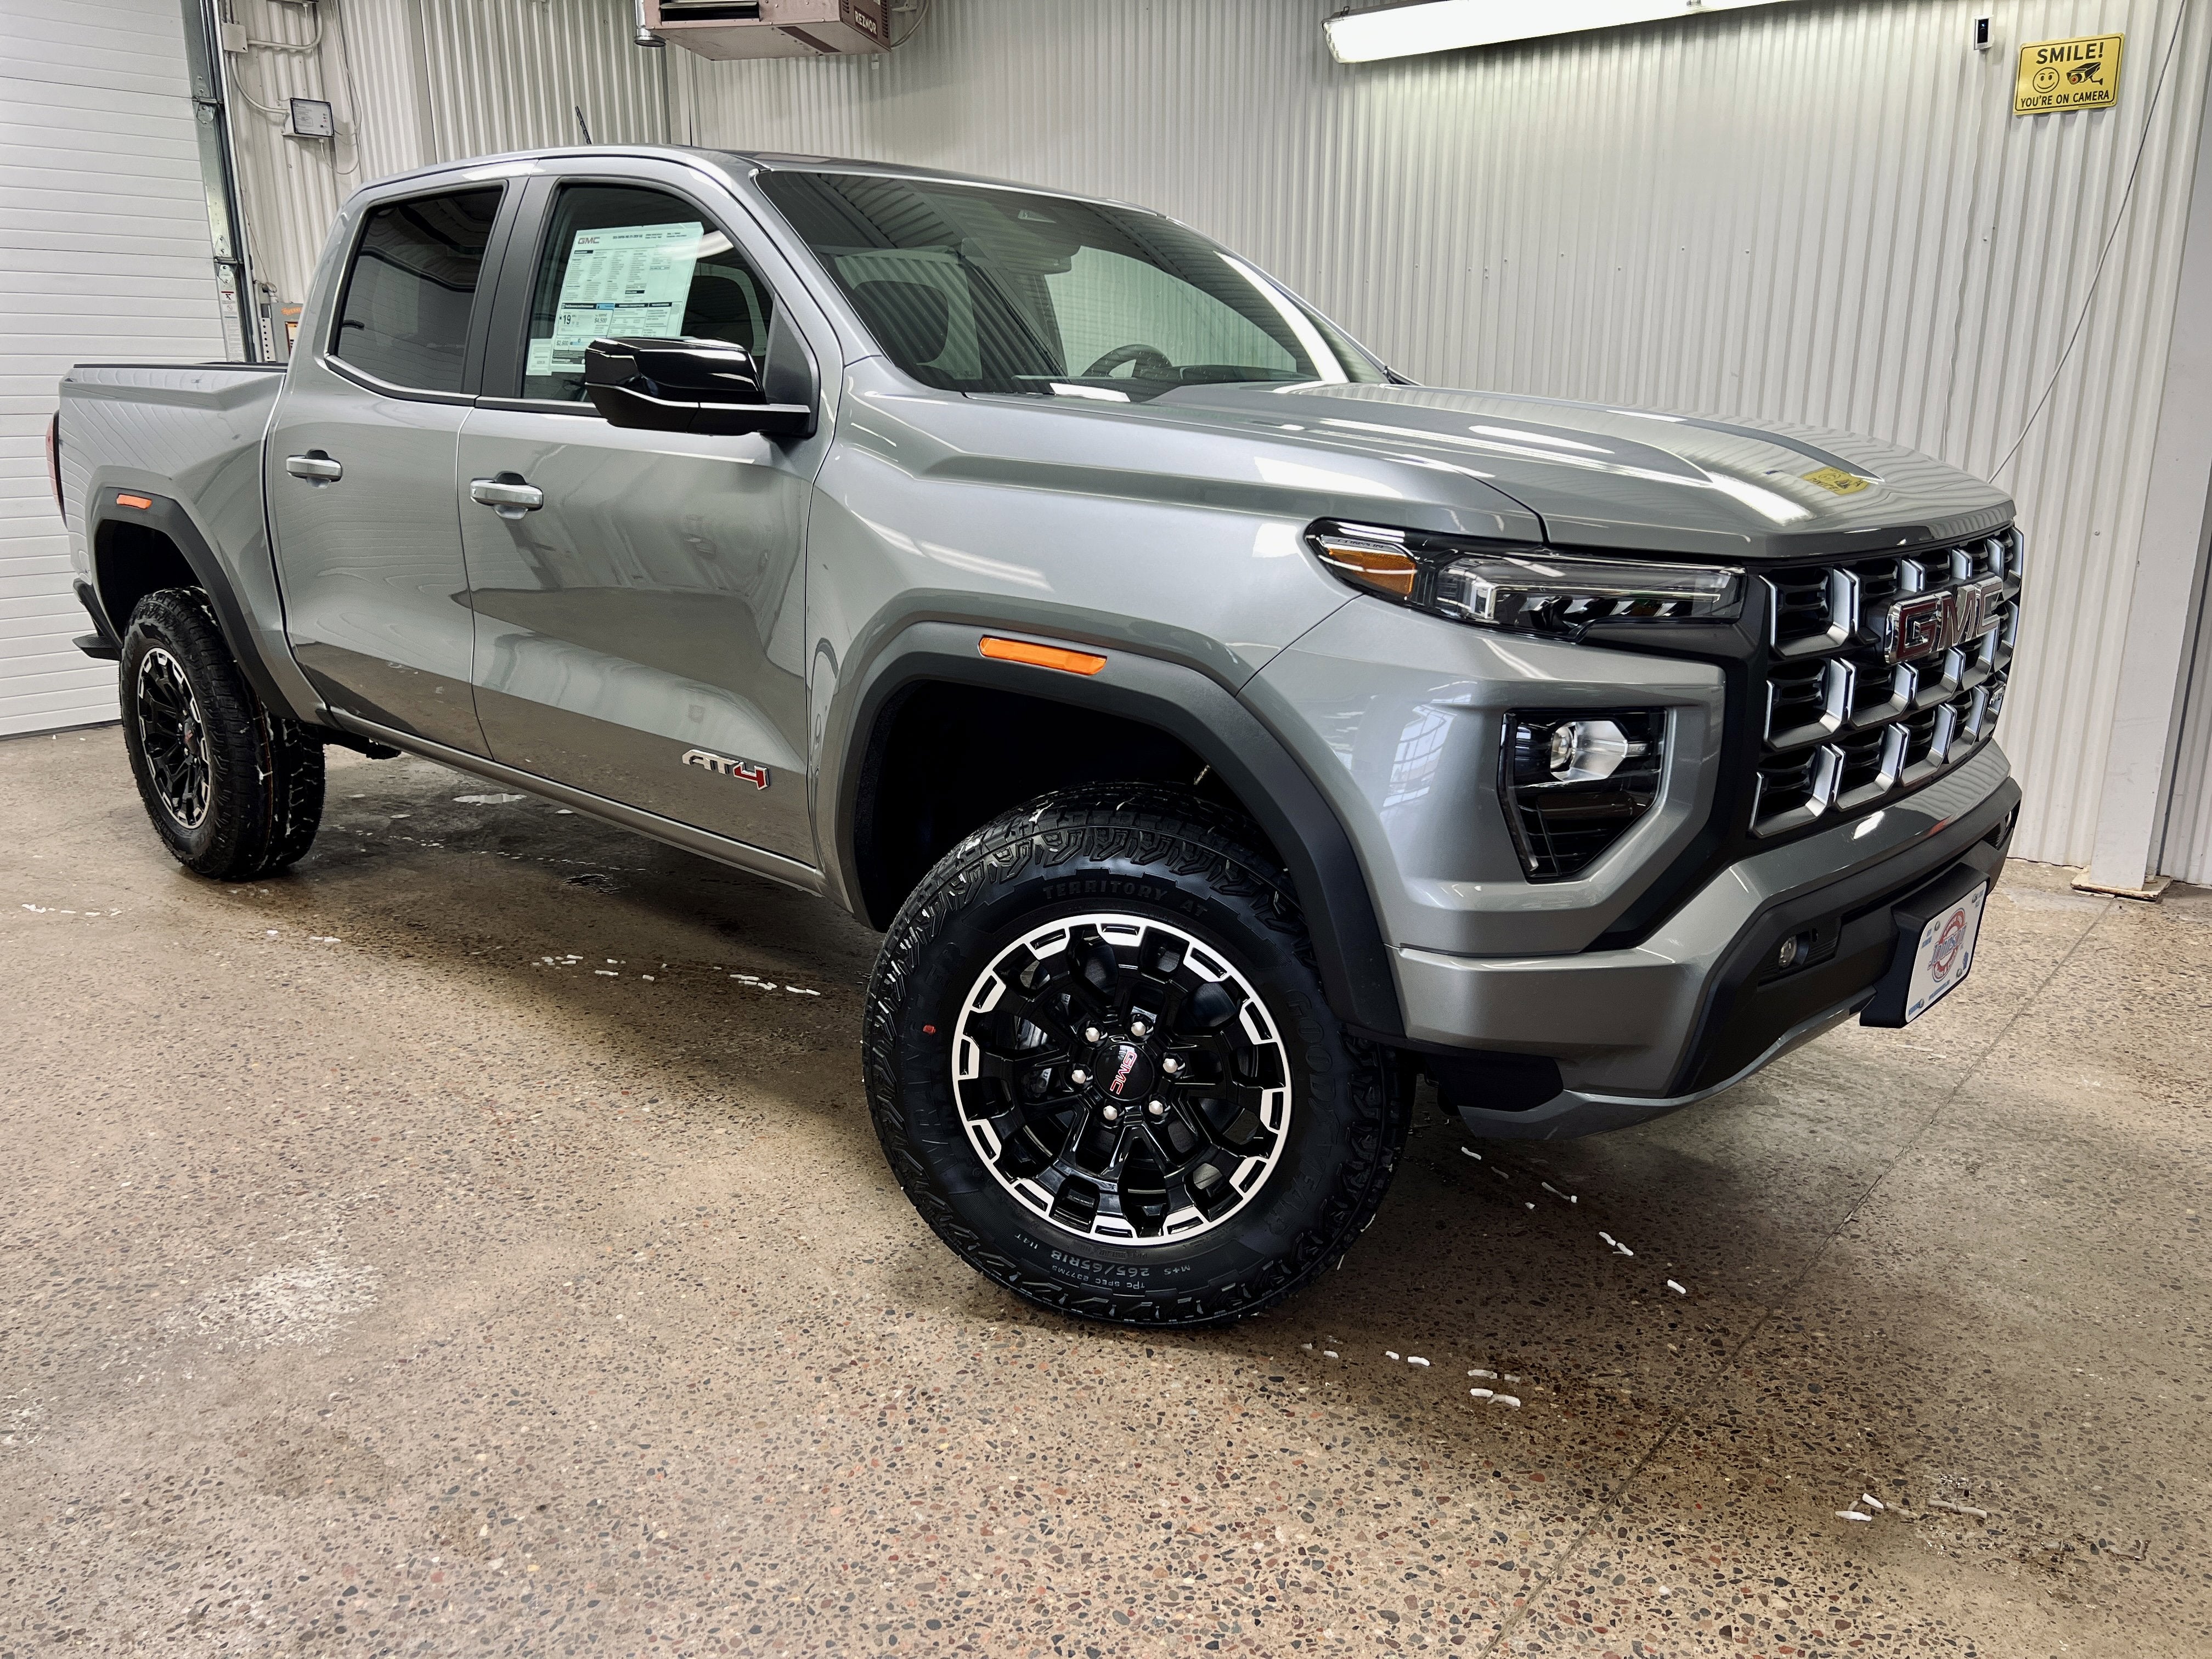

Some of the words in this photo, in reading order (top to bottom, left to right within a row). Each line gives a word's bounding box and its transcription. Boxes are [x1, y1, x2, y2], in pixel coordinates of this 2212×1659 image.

[855, 10, 877, 35] REZNOR
[2036, 42, 2104, 65] SMILE!
[2021, 95, 2053, 108] YOU'RE
[2056, 94, 2069, 104] ON
[2073, 90, 2109, 103] CAMERA
[578, 236, 601, 245] GMC
[563, 314, 571, 325] 19
[1884, 576, 2004, 664] GMC
[681, 749, 771, 791] AT4
[1042, 879, 1168, 901] TERRITORY
[1180, 899, 1209, 917] AT
[1109, 1051, 1138, 1095] GMC
[1014, 1234, 1038, 1250] 114T
[1050, 1249, 1150, 1278] 265/65R18
[1164, 1264, 1191, 1276] M+S
[1095, 1278, 1120, 1287] SPEC
[1126, 1281, 1146, 1289] TPC
